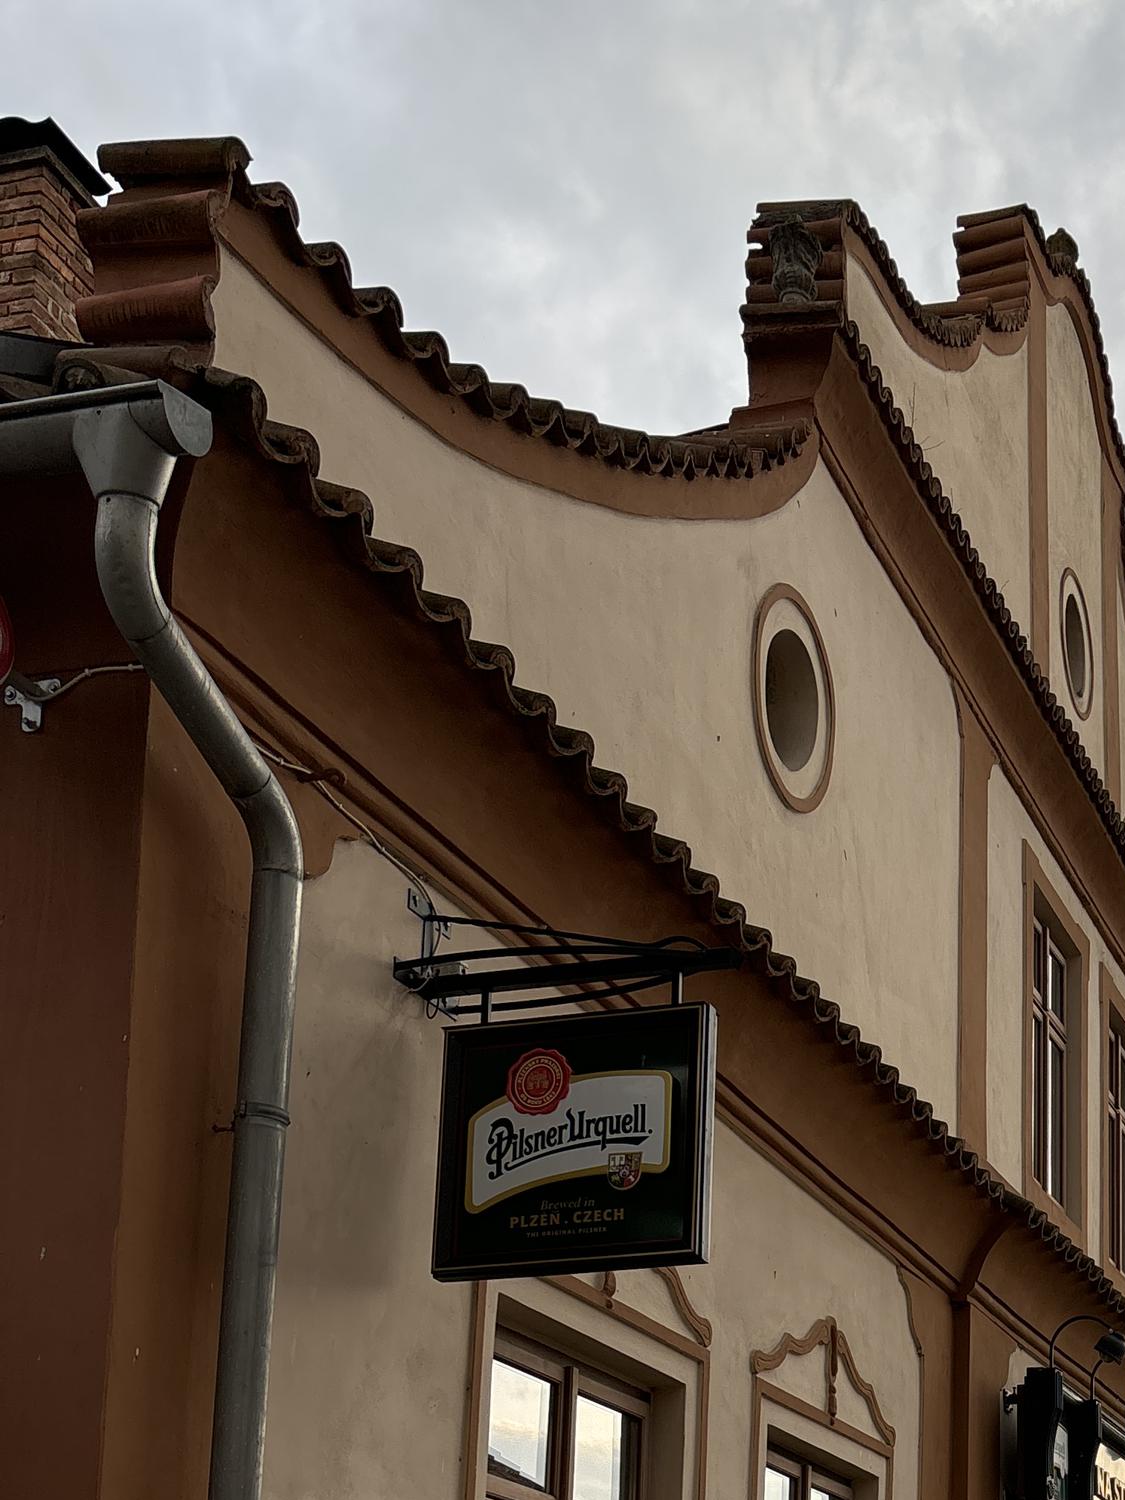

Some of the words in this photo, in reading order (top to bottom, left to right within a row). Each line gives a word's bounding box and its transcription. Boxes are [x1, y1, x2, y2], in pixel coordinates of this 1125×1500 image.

[486, 1117, 569, 1180] Pilsner
[540, 1196, 582, 1211] Brewed
[584, 1196, 595, 1208] in
[573, 1207, 625, 1224] CZECH
